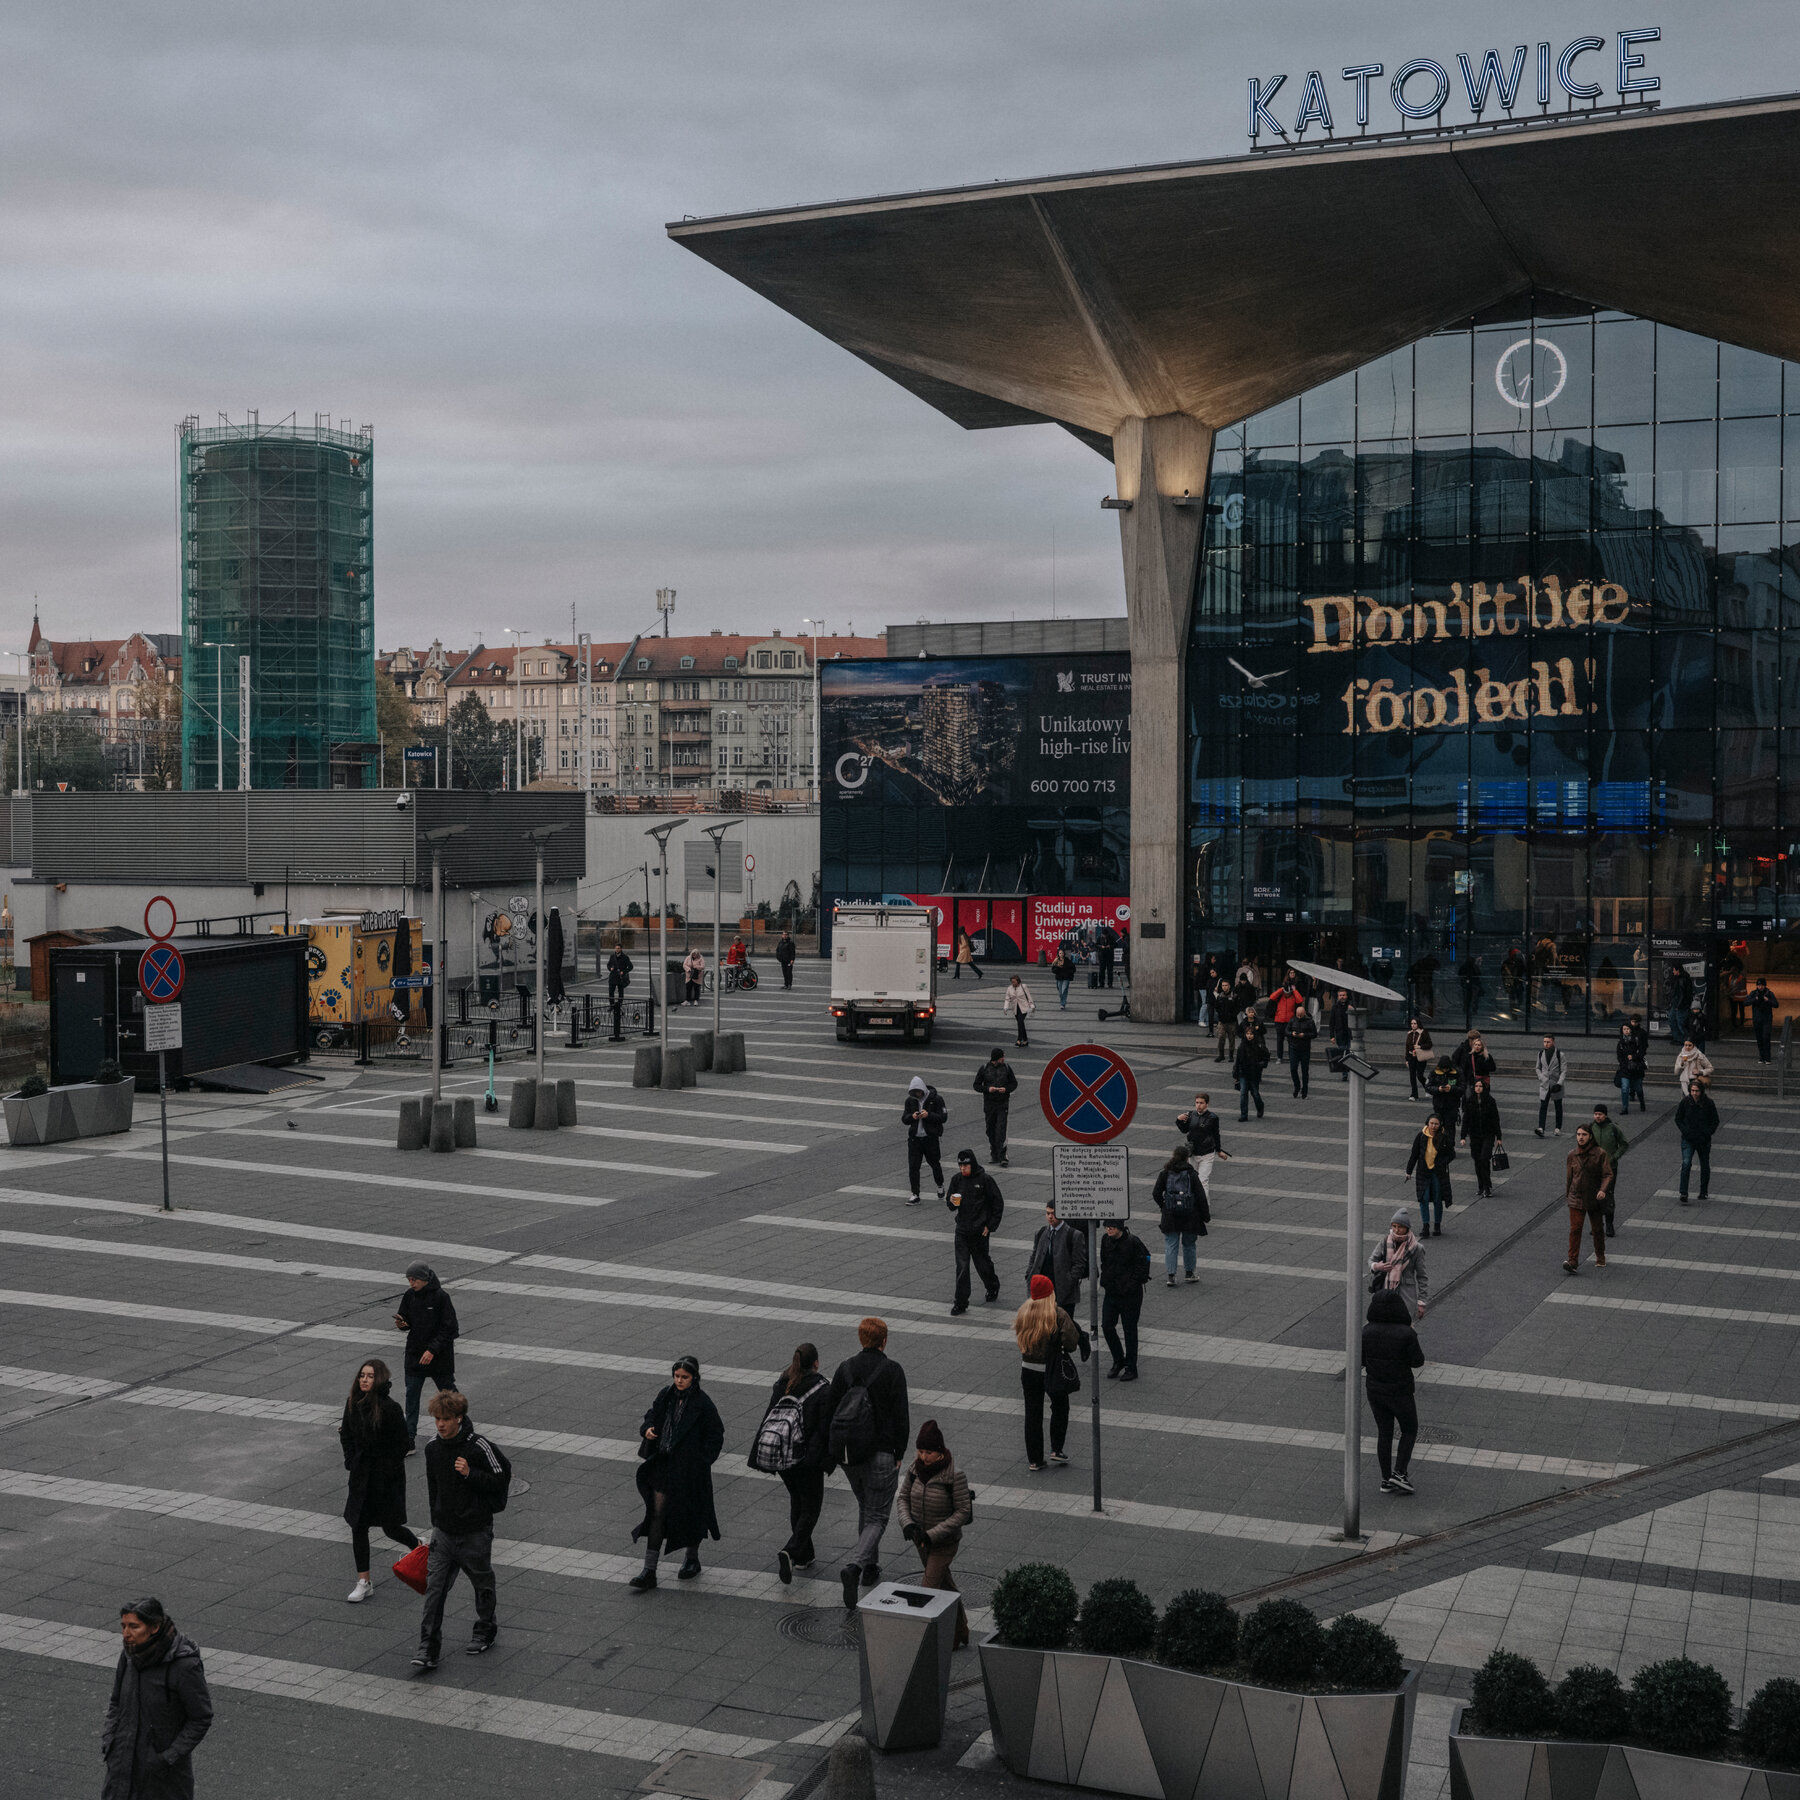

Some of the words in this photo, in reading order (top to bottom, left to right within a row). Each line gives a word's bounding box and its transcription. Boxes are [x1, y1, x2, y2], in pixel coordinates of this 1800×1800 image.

[1248, 27, 1661, 137] KATOWICE
[1080, 673, 1115, 683] TRUST
[1040, 715, 1123, 736] Unikatowy
[1040, 737, 1108, 759] high-rise
[1030, 780, 1059, 793] 600
[1062, 780, 1089, 793] 700
[1093, 780, 1116, 793] 713
[1034, 902, 1076, 916] Studiuj
[1078, 904, 1093, 914] na
[1034, 915, 1115, 930] Uniwersytecie
[1034, 926, 1079, 943] Śląskim
